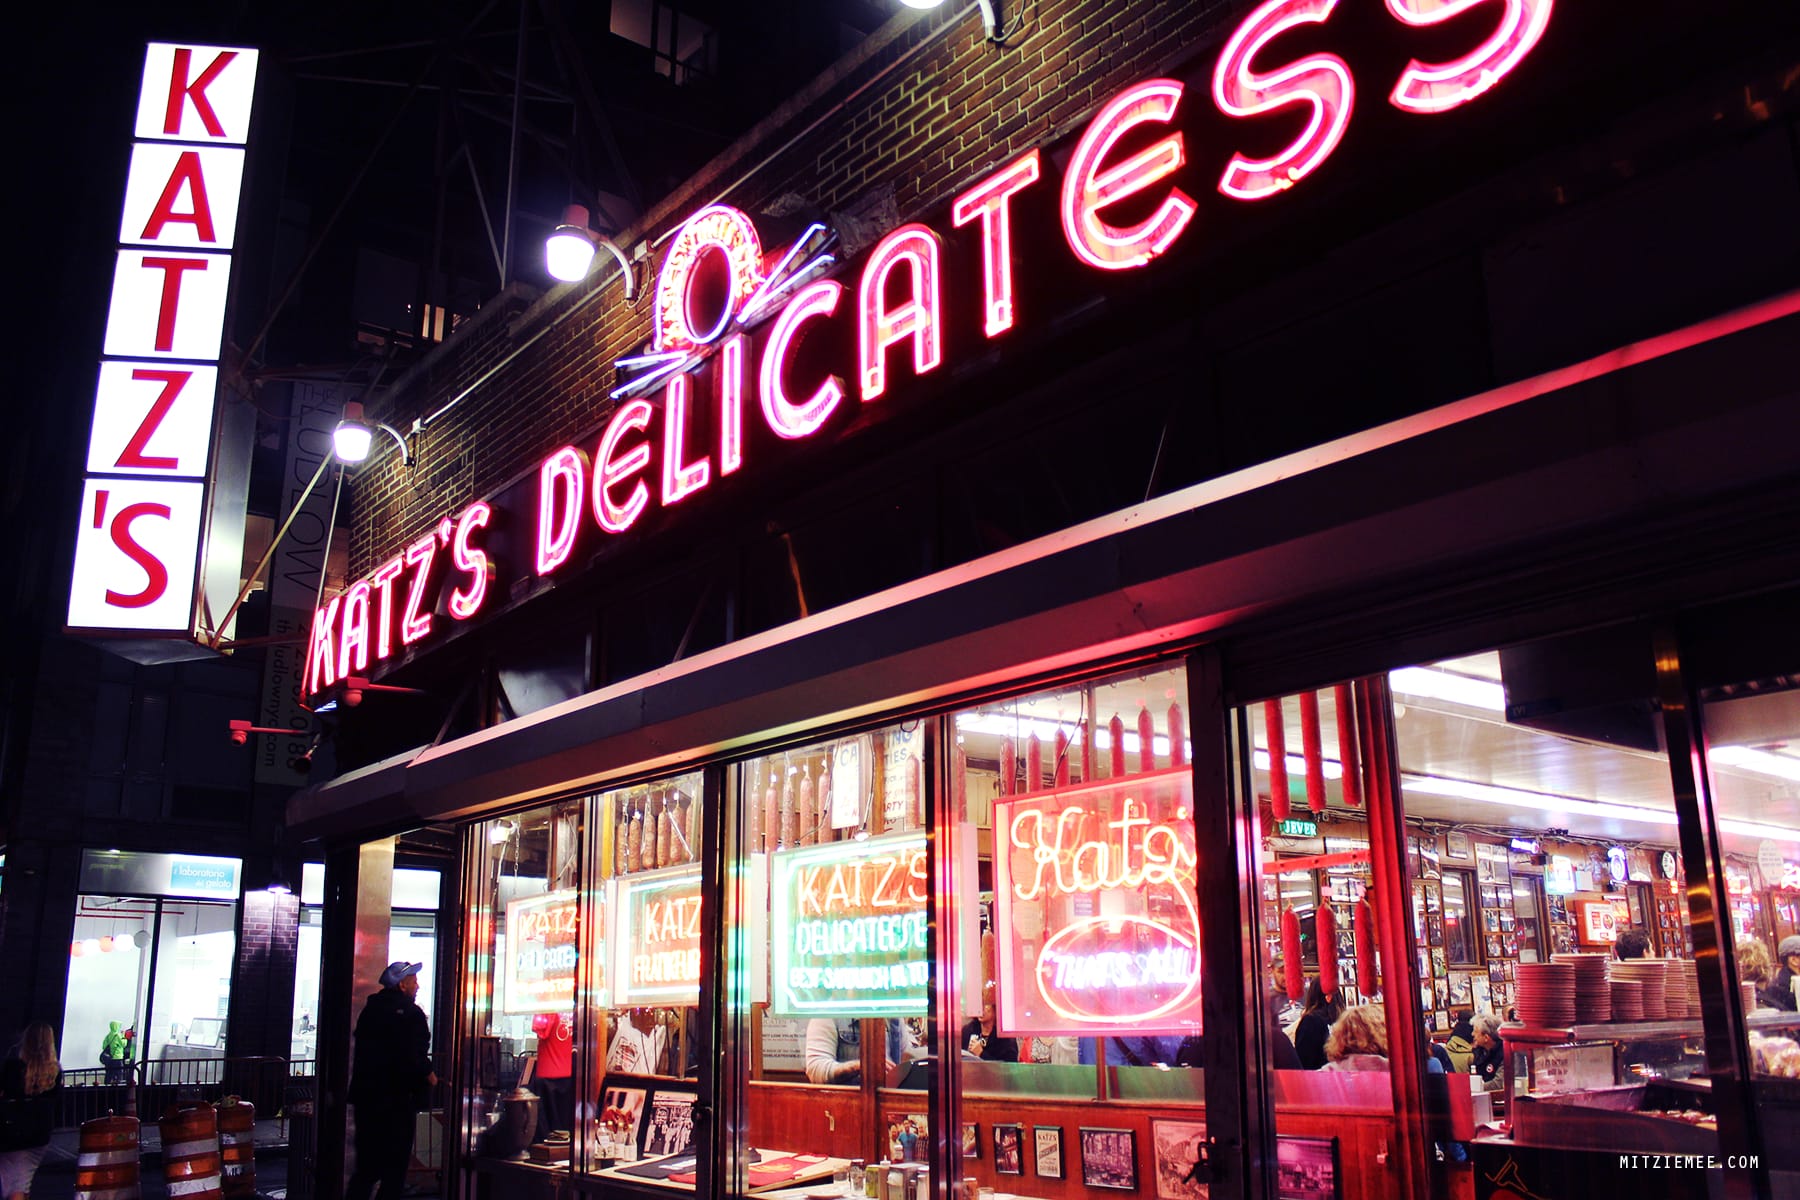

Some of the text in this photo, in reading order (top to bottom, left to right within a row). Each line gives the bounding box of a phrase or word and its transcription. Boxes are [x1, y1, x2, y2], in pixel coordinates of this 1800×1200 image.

[91, 47, 240, 609] KATZ'S
[310, 500, 492, 694] KATZ'S
[797, 850, 928, 916] KATZ'S
[1284, 820, 1317, 836] JEVER
